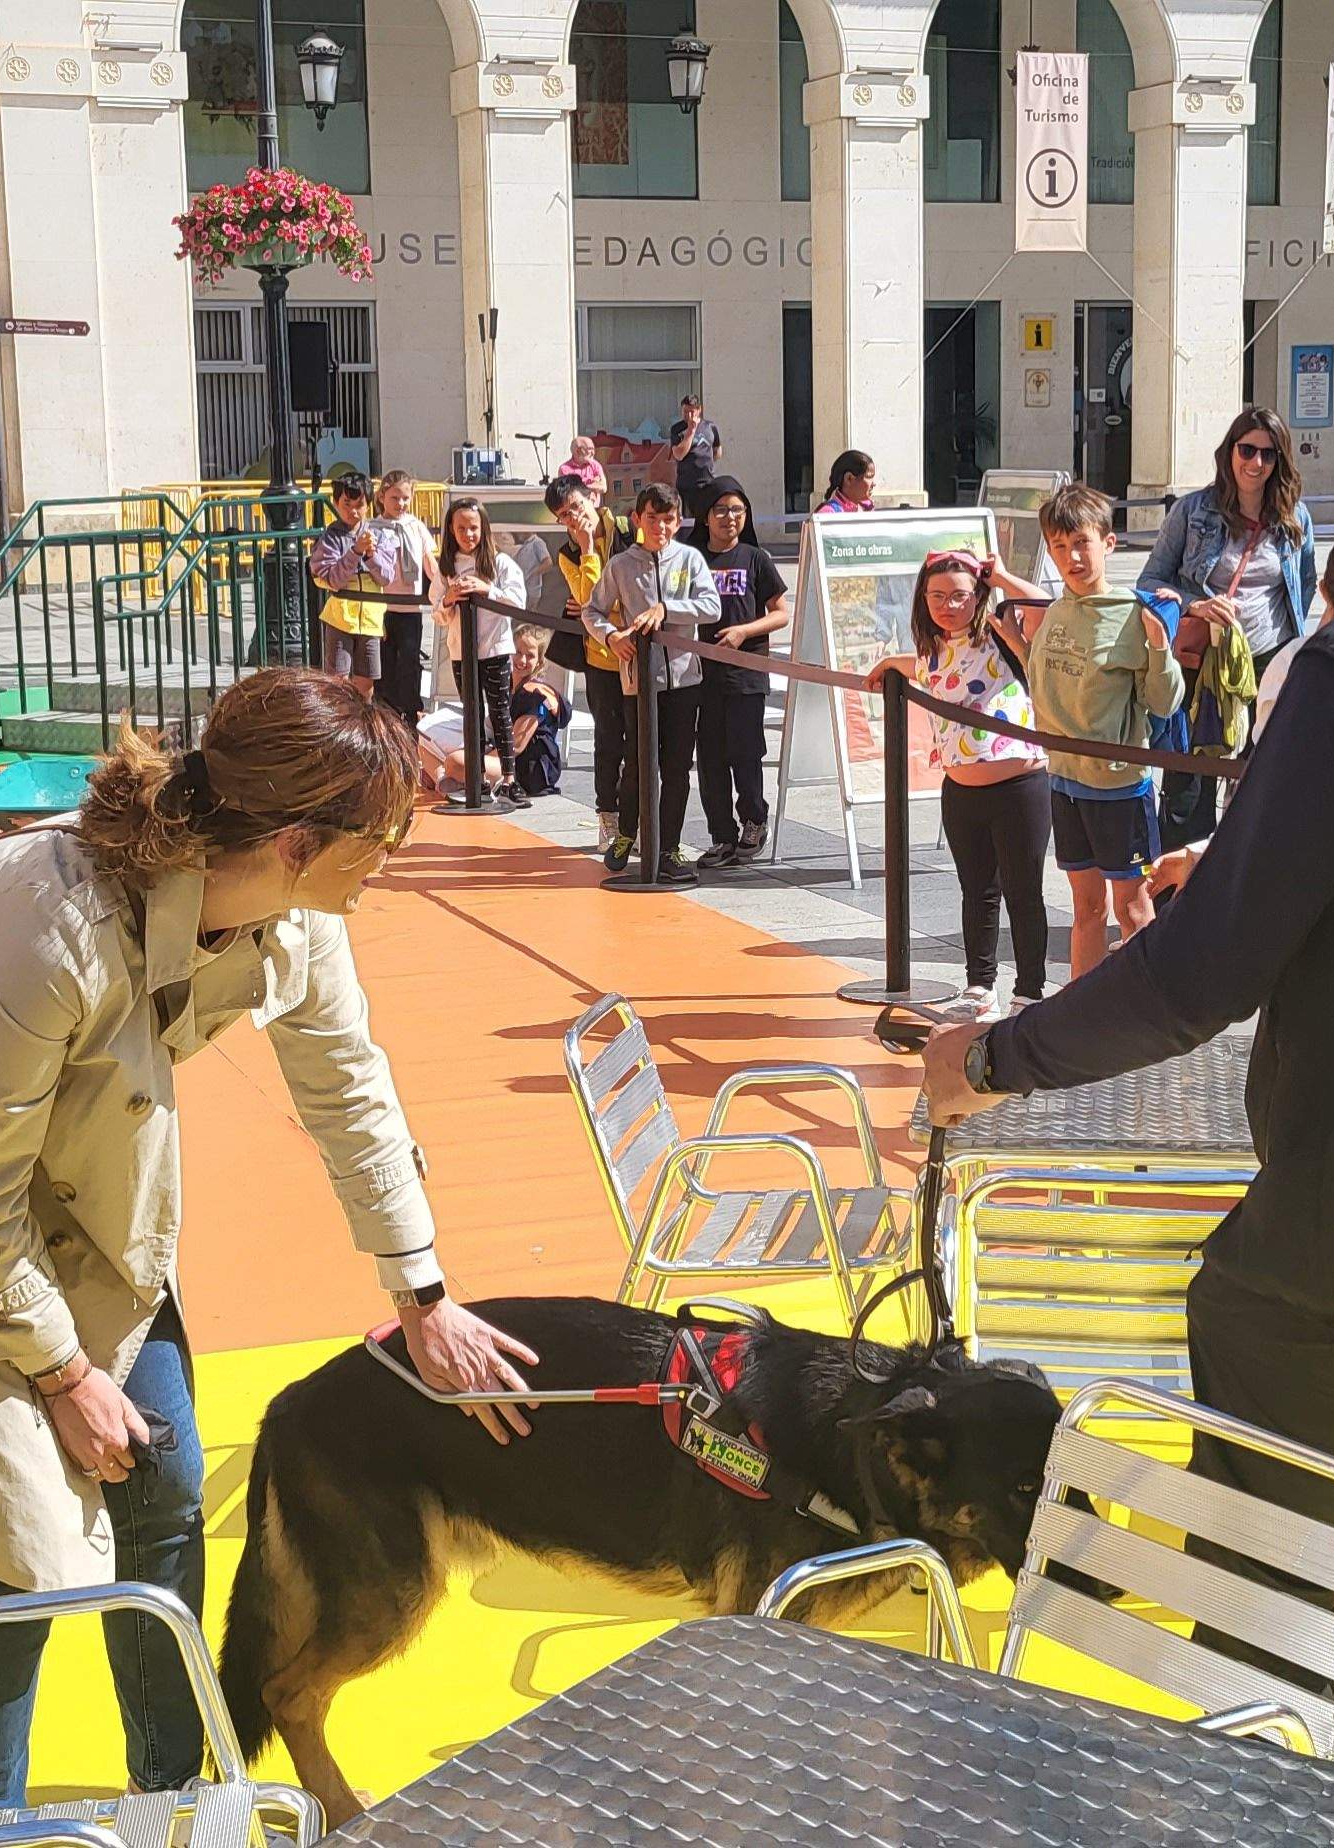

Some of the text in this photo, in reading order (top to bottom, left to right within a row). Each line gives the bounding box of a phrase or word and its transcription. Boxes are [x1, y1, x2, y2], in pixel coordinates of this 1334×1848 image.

[1032, 73, 1079, 88] Oficina
[1062, 91, 1079, 105] de
[1025, 109, 1079, 123] Turismo
[1091, 155, 1135, 169] Tradició
[322, 229, 812, 267] USE EDAGÓGIC
[1107, 336, 1132, 376] BIENVE
[831, 543, 893, 557] Zona de obras
[725, 1451, 761, 1476] ONCE
